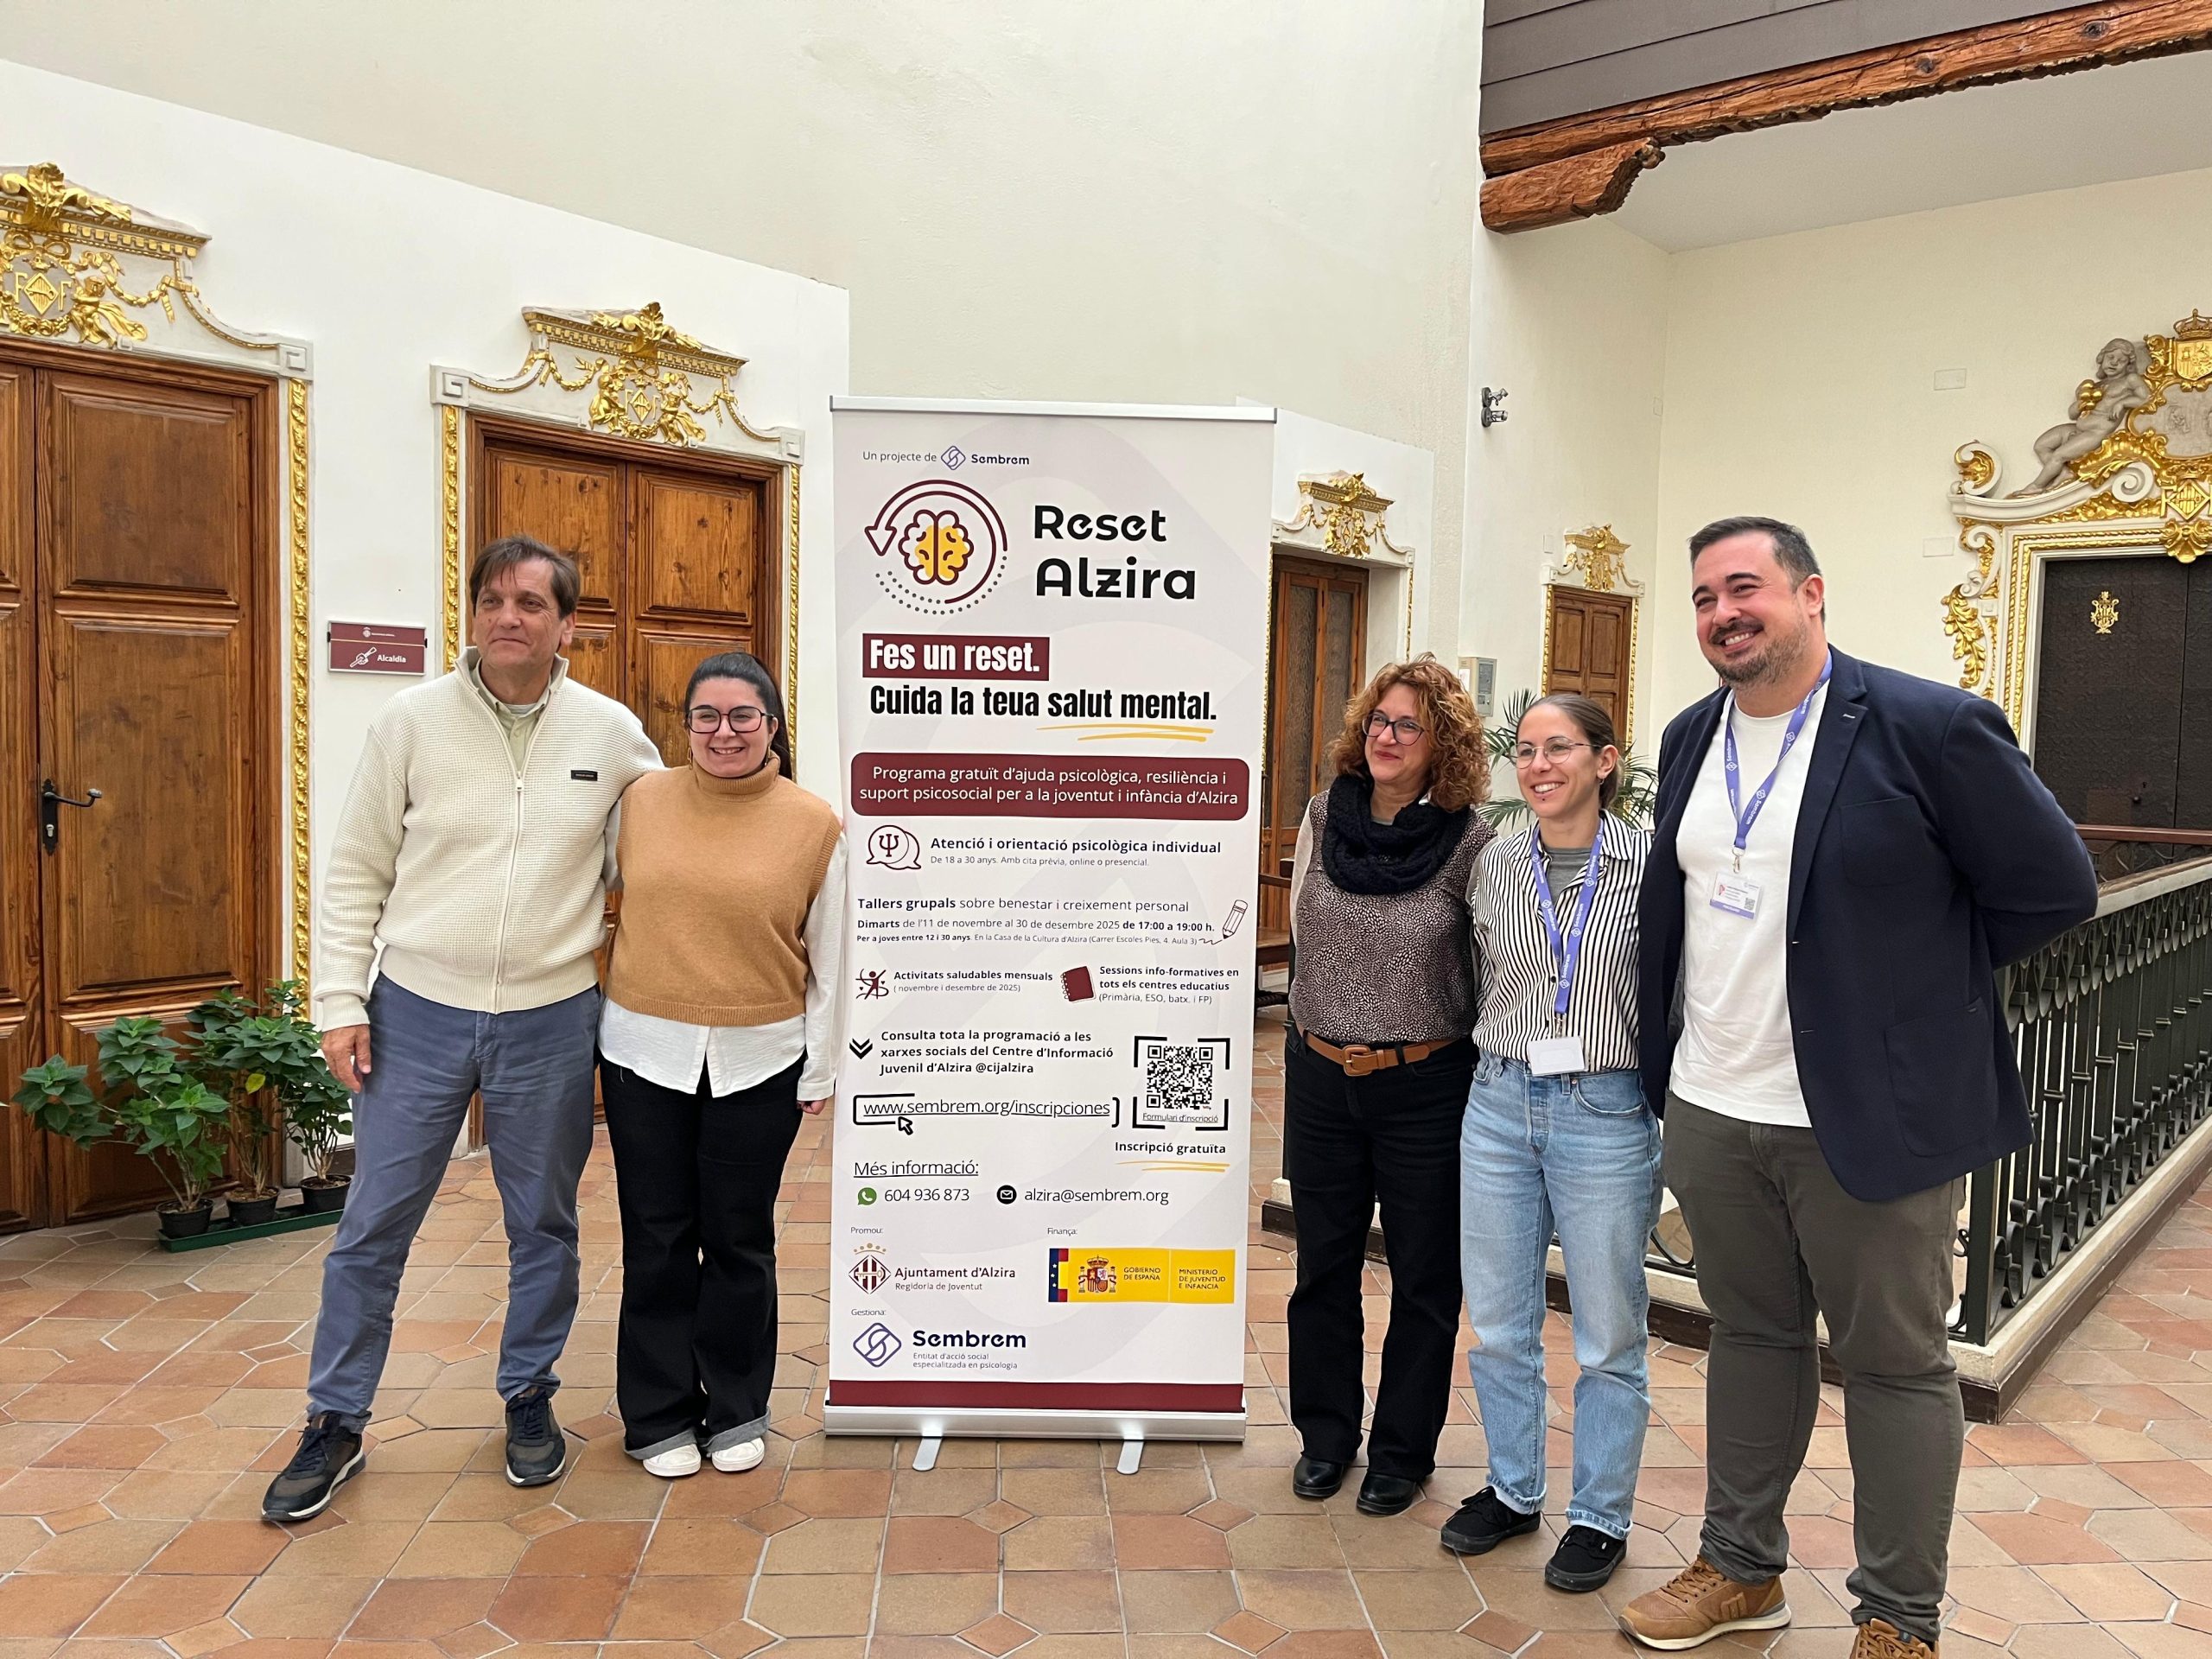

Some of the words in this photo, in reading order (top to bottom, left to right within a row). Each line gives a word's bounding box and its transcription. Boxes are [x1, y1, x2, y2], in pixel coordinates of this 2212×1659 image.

[862, 451, 877, 461] Un
[880, 453, 922, 463] projecte
[924, 452, 937, 462] de
[971, 454, 1030, 465] Sembrem
[1035, 505, 1166, 542] Reset
[1037, 556, 1195, 599] Alzira
[377, 654, 406, 663] Alcaldia
[871, 639, 915, 669] Fes
[924, 645, 956, 670] un
[965, 643, 1039, 671] reset.
[871, 685, 942, 715] Cuida
[951, 687, 973, 715] la
[983, 688, 1039, 716] teua
[1048, 690, 1112, 717] salut
[1121, 691, 1217, 720] mental.
[874, 766, 945, 782] Programa
[950, 768, 998, 783] gratuït
[1003, 767, 1054, 784] d'ajuda
[1059, 769, 1141, 785] psicològica,
[1147, 770, 1218, 785] resiliència
[860, 787, 909, 803] suport
[914, 787, 991, 803] psicosocial
[996, 790, 1021, 804] per
[1025, 790, 1033, 801] a
[1038, 787, 1050, 801] la
[1053, 789, 1114, 804] joventut
[1126, 789, 1182, 804] infància
[1186, 790, 1238, 804] d'Alzira
[930, 837, 985, 849] Atenció
[988, 838, 993, 849] i
[996, 837, 1068, 851] orientació
[1072, 839, 1147, 855] psicològica
[1152, 840, 1221, 854] individual
[931, 855, 943, 864] De
[944, 855, 956, 864] 18
[964, 855, 976, 864] 30
[1039, 857, 1068, 867] prèvia,
[1069, 857, 1096, 866] online
[857, 898, 903, 909] Tallers
[906, 897, 957, 912] grupals
[959, 898, 995, 909] sobre
[999, 898, 1053, 910] benestar
[1063, 899, 1132, 911] creixement
[1135, 901, 1189, 913] personal
[857, 919, 900, 929] Dimarts
[902, 918, 915, 928] de
[937, 918, 949, 928] de
[952, 918, 1002, 928] novembre
[1005, 918, 1014, 928] al
[1015, 918, 1028, 928] 30
[1030, 919, 1043, 929] de
[1045, 920, 1094, 930] desembre
[1096, 920, 1120, 930] 2025
[1122, 920, 1135, 930] de
[1138, 921, 1165, 931] 17:00
[1176, 923, 1203, 931] 19:00
[1205, 922, 1216, 931] h.
[878, 935, 900, 944] joves
[1190, 938, 1198, 946] 3)
[893, 970, 944, 980] Activitats
[946, 970, 1002, 979] saludables
[1004, 972, 1053, 981] mensuals
[1099, 966, 1143, 975] Sessions
[1145, 966, 1224, 977] info-formatives
[998, 983, 1021, 993] 2025)
[1122, 979, 1136, 988] els
[1139, 982, 1178, 990] centres
[1179, 982, 1230, 991] educatius
[1098, 993, 1143, 1002] (Primària,
[1145, 994, 1166, 1003] ESO,
[1198, 995, 1212, 1005] FP)
[880, 1029, 936, 1041] Consulta
[939, 1031, 965, 1039] tota
[969, 1029, 980, 1039] la
[983, 1031, 1061, 1042] programació
[1064, 1033, 1071, 1042] a
[1074, 1031, 1091, 1042] les
[880, 1048, 922, 1058] xarxes
[925, 1046, 967, 1057] socials
[969, 1046, 988, 1056] del
[992, 1046, 1033, 1057] Centre
[1036, 1047, 1114, 1058] d'Informació
[879, 1062, 923, 1076] Juvenil
[926, 1062, 972, 1072] d'Alzira
[975, 1062, 1034, 1075] @cijalzira
[864, 1099, 1110, 1117] www.sembrem.org/inscripciones
[1115, 1141, 1173, 1154] Inscripció
[1176, 1144, 1226, 1156] gratuïta
[855, 1161, 887, 1176] Més
[892, 1160, 979, 1176] informació:
[884, 1188, 911, 1202] 604
[914, 1188, 940, 1201] 936
[944, 1188, 969, 1201] 873
[1025, 1188, 1168, 1205] alzira@sembrem.org
[894, 1267, 968, 1281] Ajuntament
[970, 1267, 1015, 1278] d'Alzira
[1134, 1273, 1161, 1281] ESPAÑA
[895, 1281, 933, 1292] Regidoria
[947, 1282, 982, 1292] Joventut
[913, 1331, 1026, 1348] Sembrem
[912, 1361, 966, 1370] especialitzada
[980, 1361, 1018, 1370] psicologia
